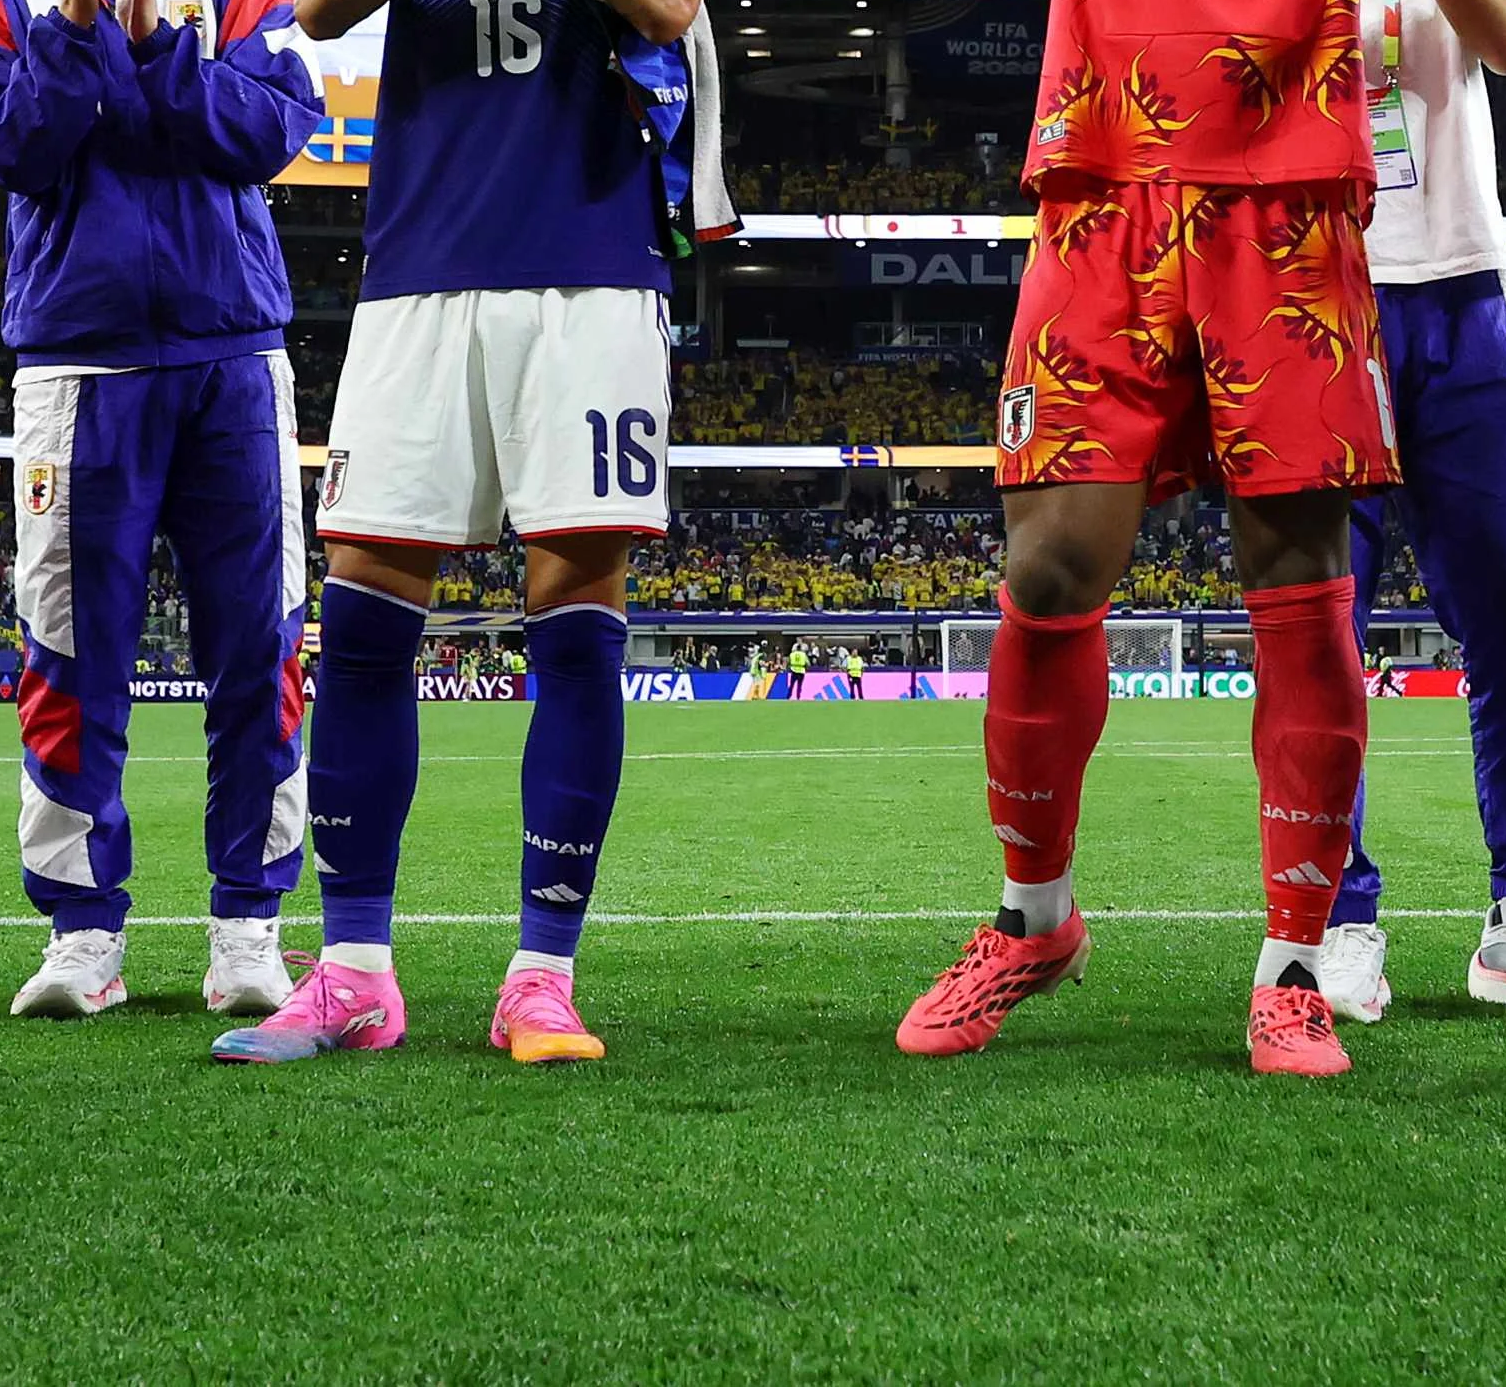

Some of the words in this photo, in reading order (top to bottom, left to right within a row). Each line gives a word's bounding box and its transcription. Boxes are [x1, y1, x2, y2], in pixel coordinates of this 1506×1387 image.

[985, 22, 1028, 39] FIFA
[946, 40, 1021, 58] WORLD
[871, 253, 1024, 285] DAL
[586, 409, 656, 498] 16
[417, 675, 513, 700] RWAYS
[621, 673, 695, 701] VISA
[1262, 803, 1353, 826] JAPAN
[524, 830, 594, 855] JAPAN
